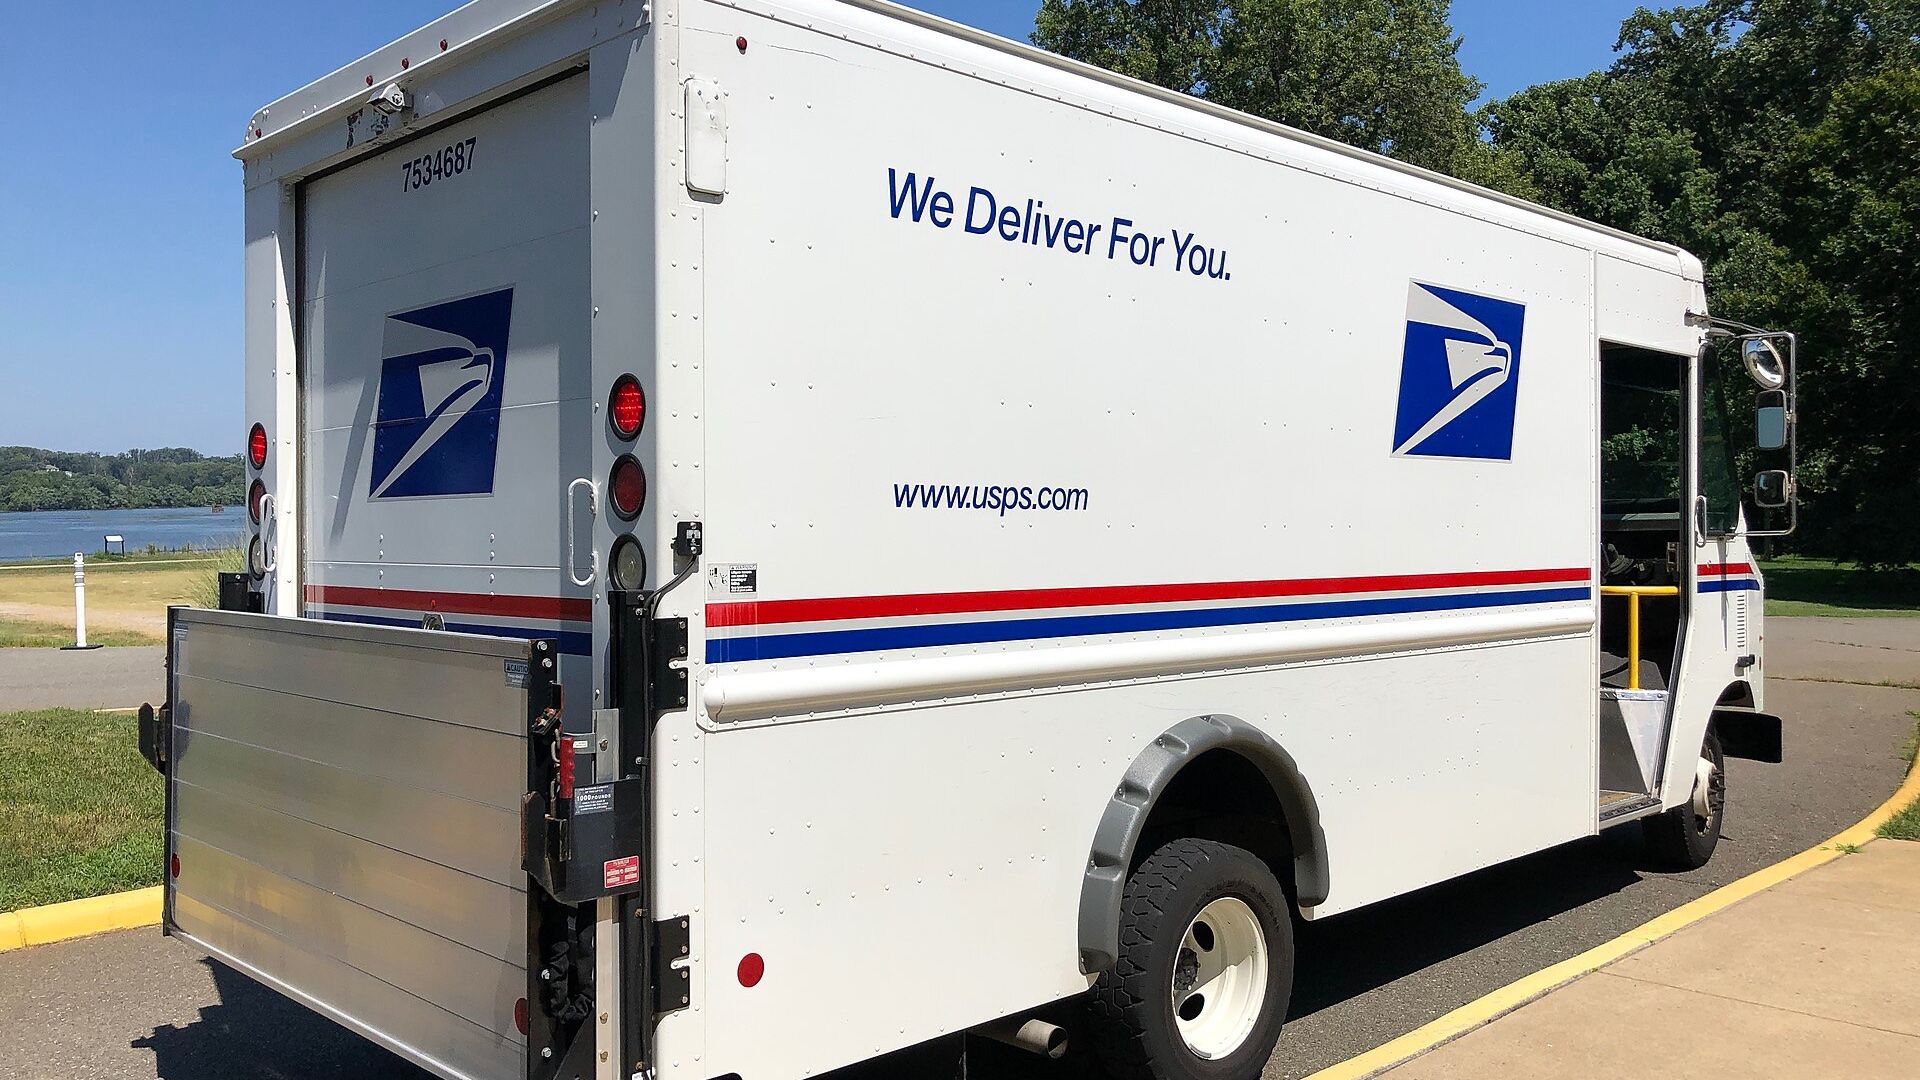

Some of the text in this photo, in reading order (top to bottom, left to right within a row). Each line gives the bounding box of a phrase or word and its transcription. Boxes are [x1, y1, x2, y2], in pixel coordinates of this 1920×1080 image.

[402, 136, 477, 193] 7534687
[888, 167, 1231, 281] We Deliver For You.
[893, 483, 1089, 518] www.usps.com
[510, 664, 529, 673] CAUTIO
[576, 794, 591, 802] 1000
